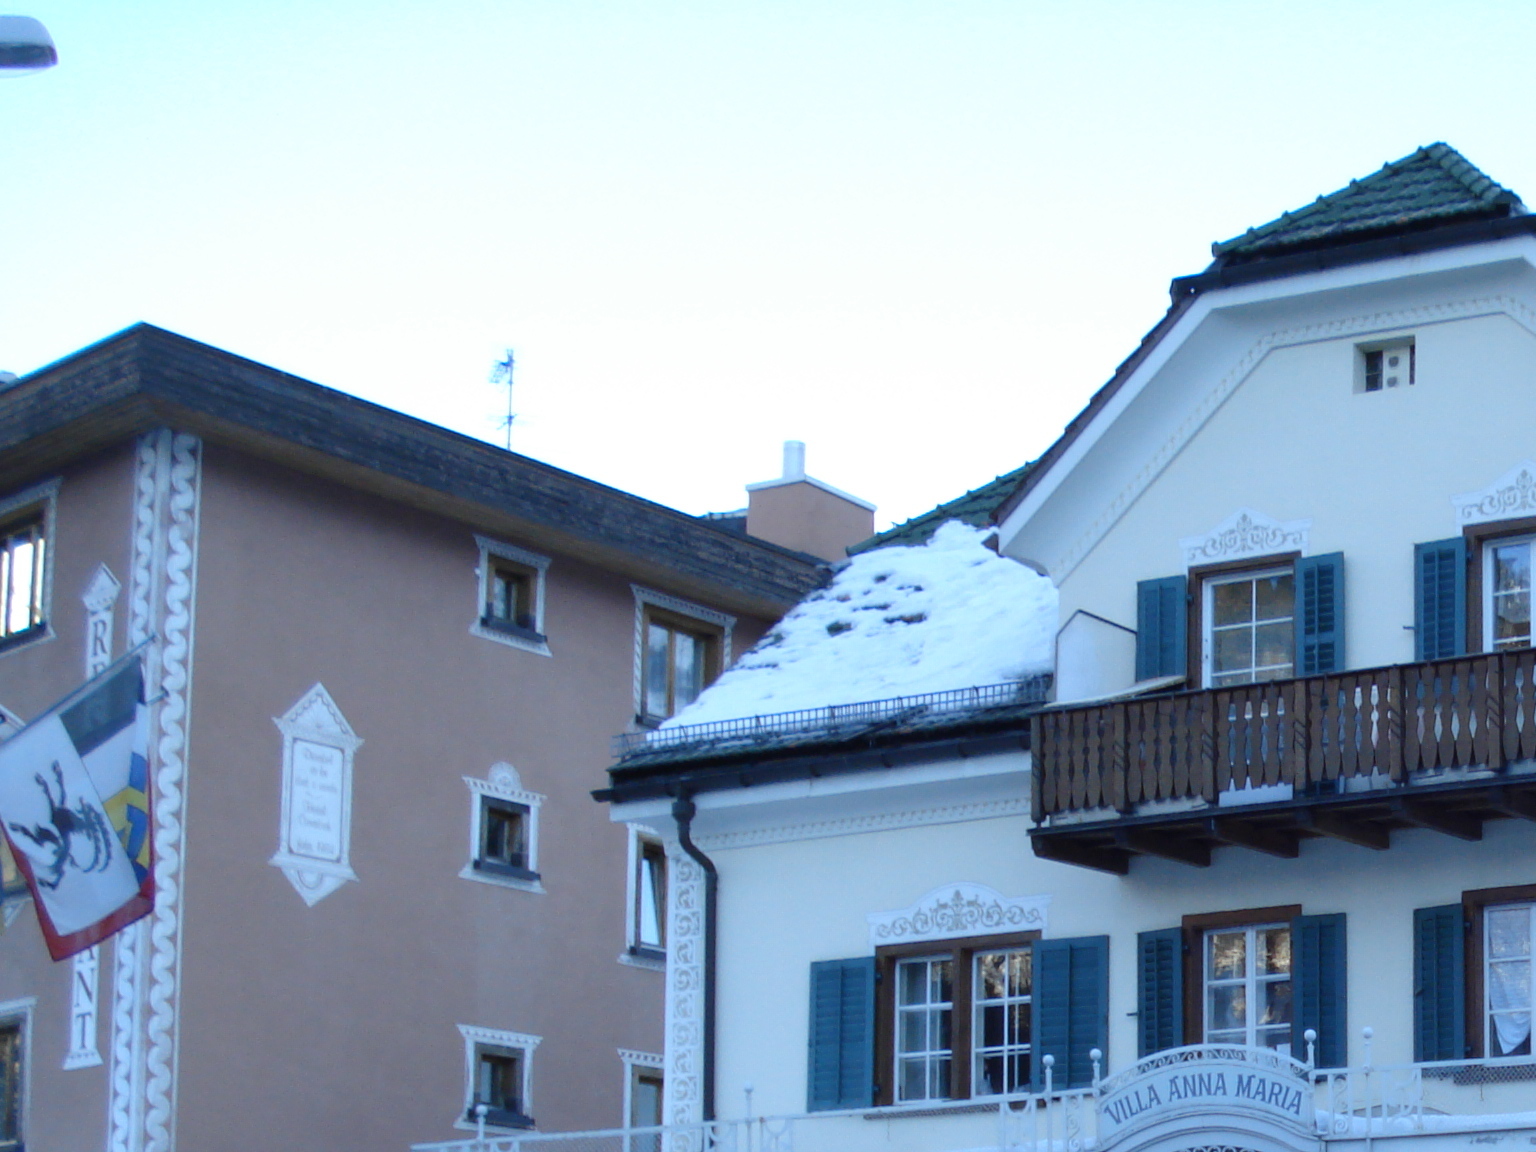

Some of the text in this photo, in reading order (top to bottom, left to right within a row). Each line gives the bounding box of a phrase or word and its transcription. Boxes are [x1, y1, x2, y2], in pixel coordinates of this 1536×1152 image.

[1103, 1072, 1303, 1126] VILLA ANNA MARIA
